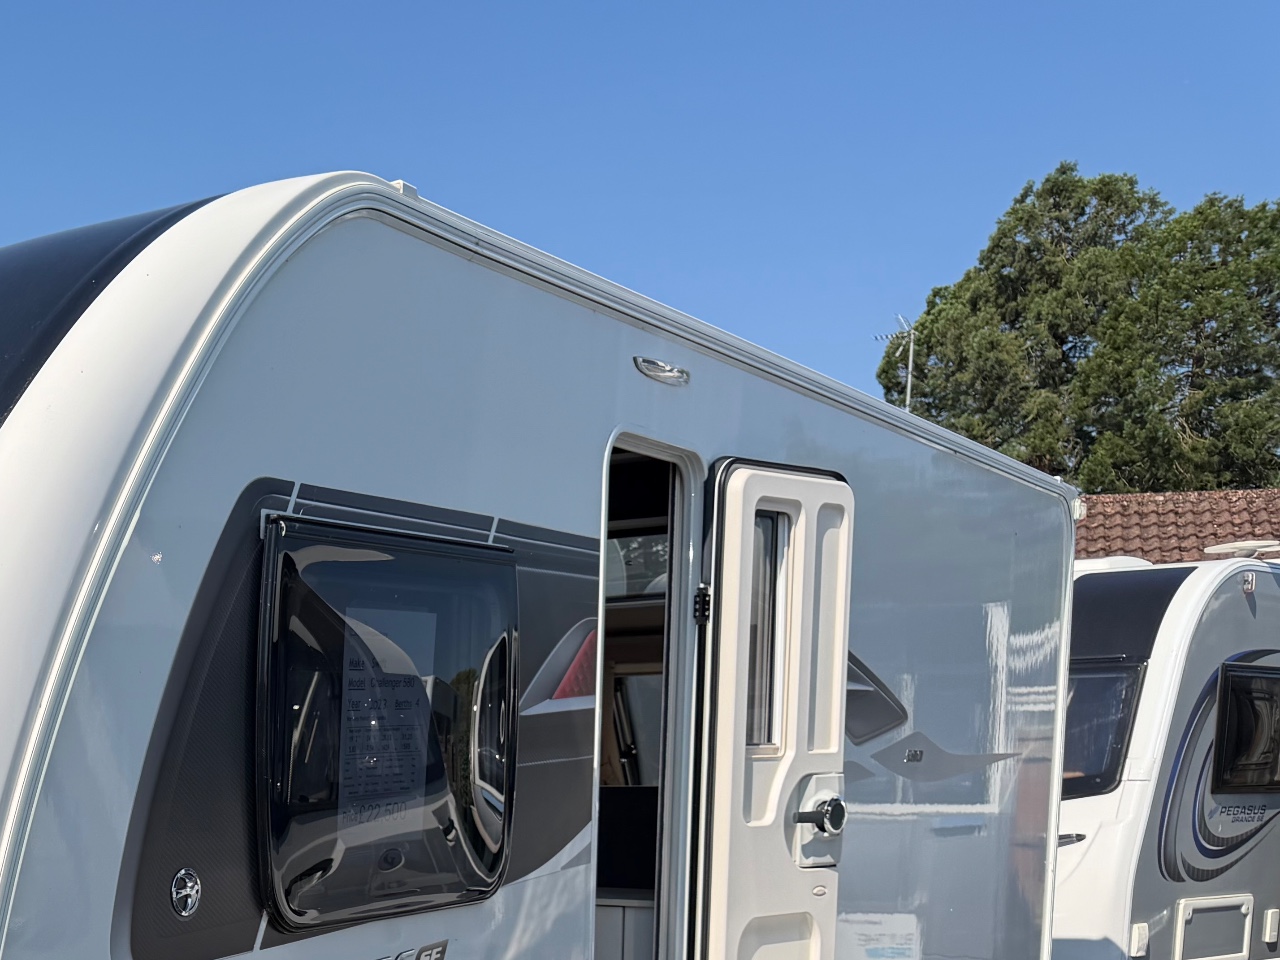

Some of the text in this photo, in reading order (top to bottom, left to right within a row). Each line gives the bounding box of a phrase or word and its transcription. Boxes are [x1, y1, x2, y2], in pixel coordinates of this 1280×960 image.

[347, 677, 366, 688] Model
[347, 699, 361, 709] Year
[1220, 804, 1267, 816] PEGASUS
[1231, 815, 1255, 823] GRANDE
